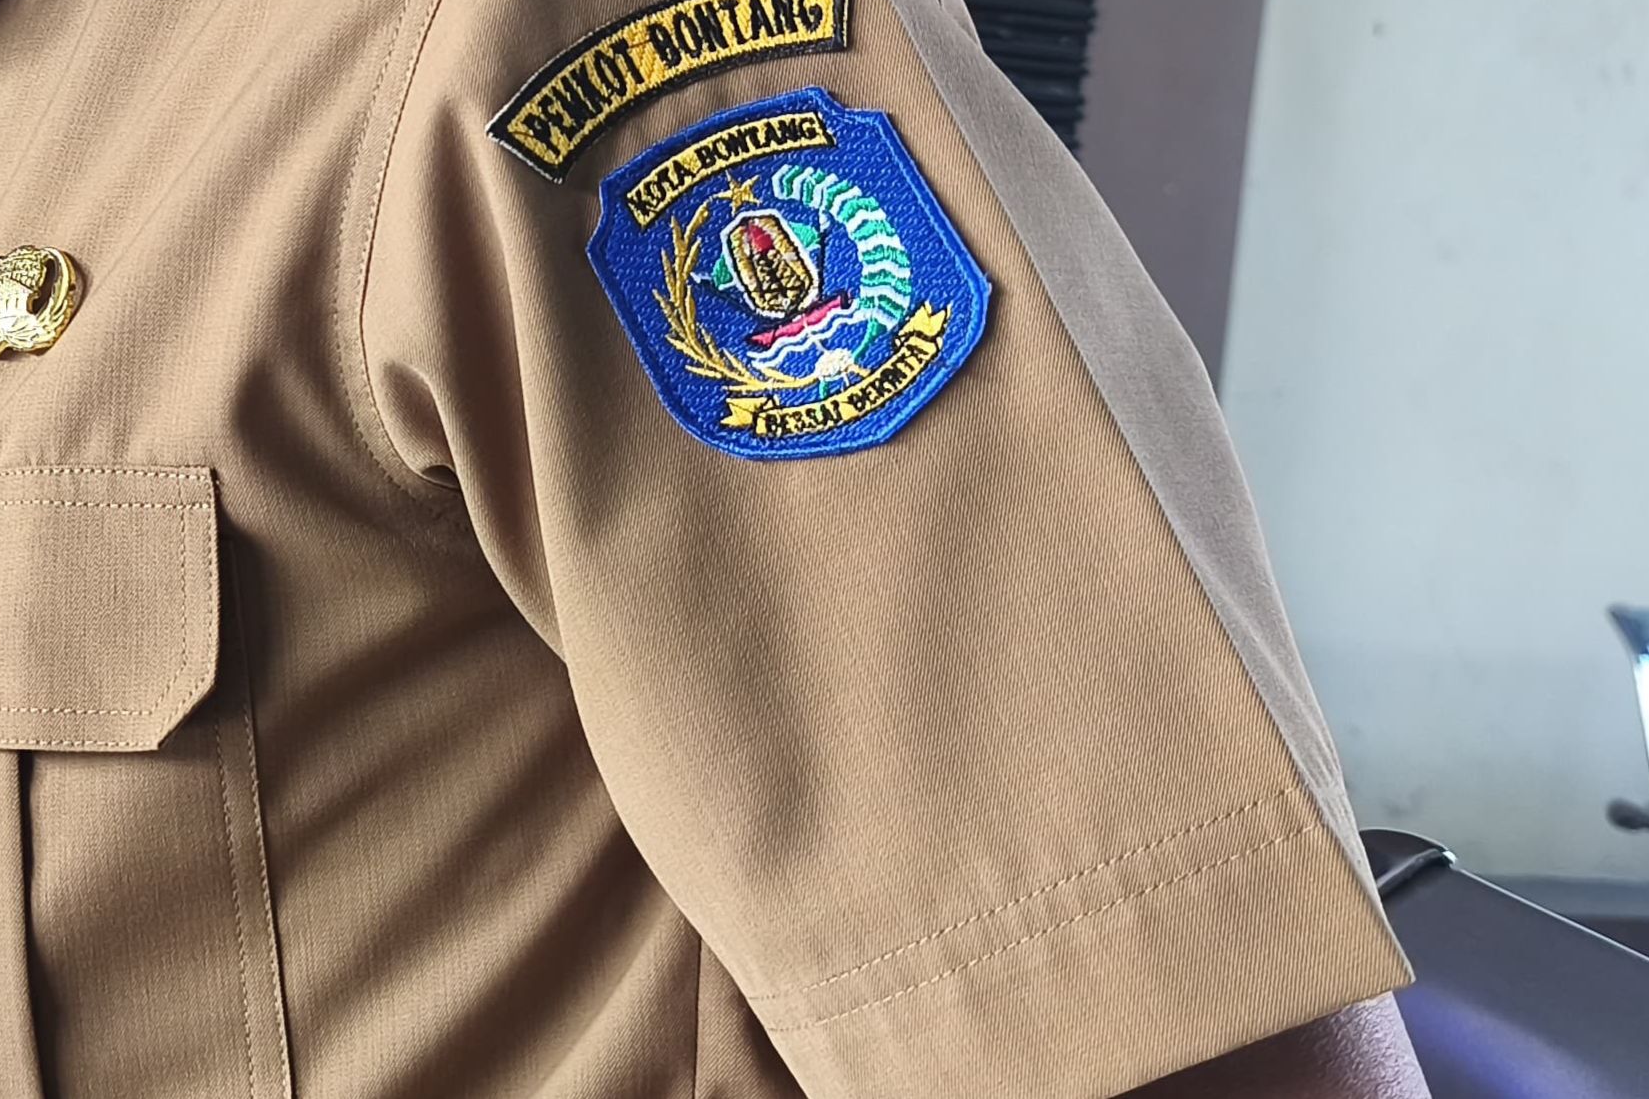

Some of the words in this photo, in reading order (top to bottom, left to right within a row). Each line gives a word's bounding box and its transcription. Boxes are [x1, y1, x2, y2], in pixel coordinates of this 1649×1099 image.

[522, 38, 645, 158] PEMKOT
[628, 160, 696, 217] KOTA
[696, 116, 820, 170] BONTANG
